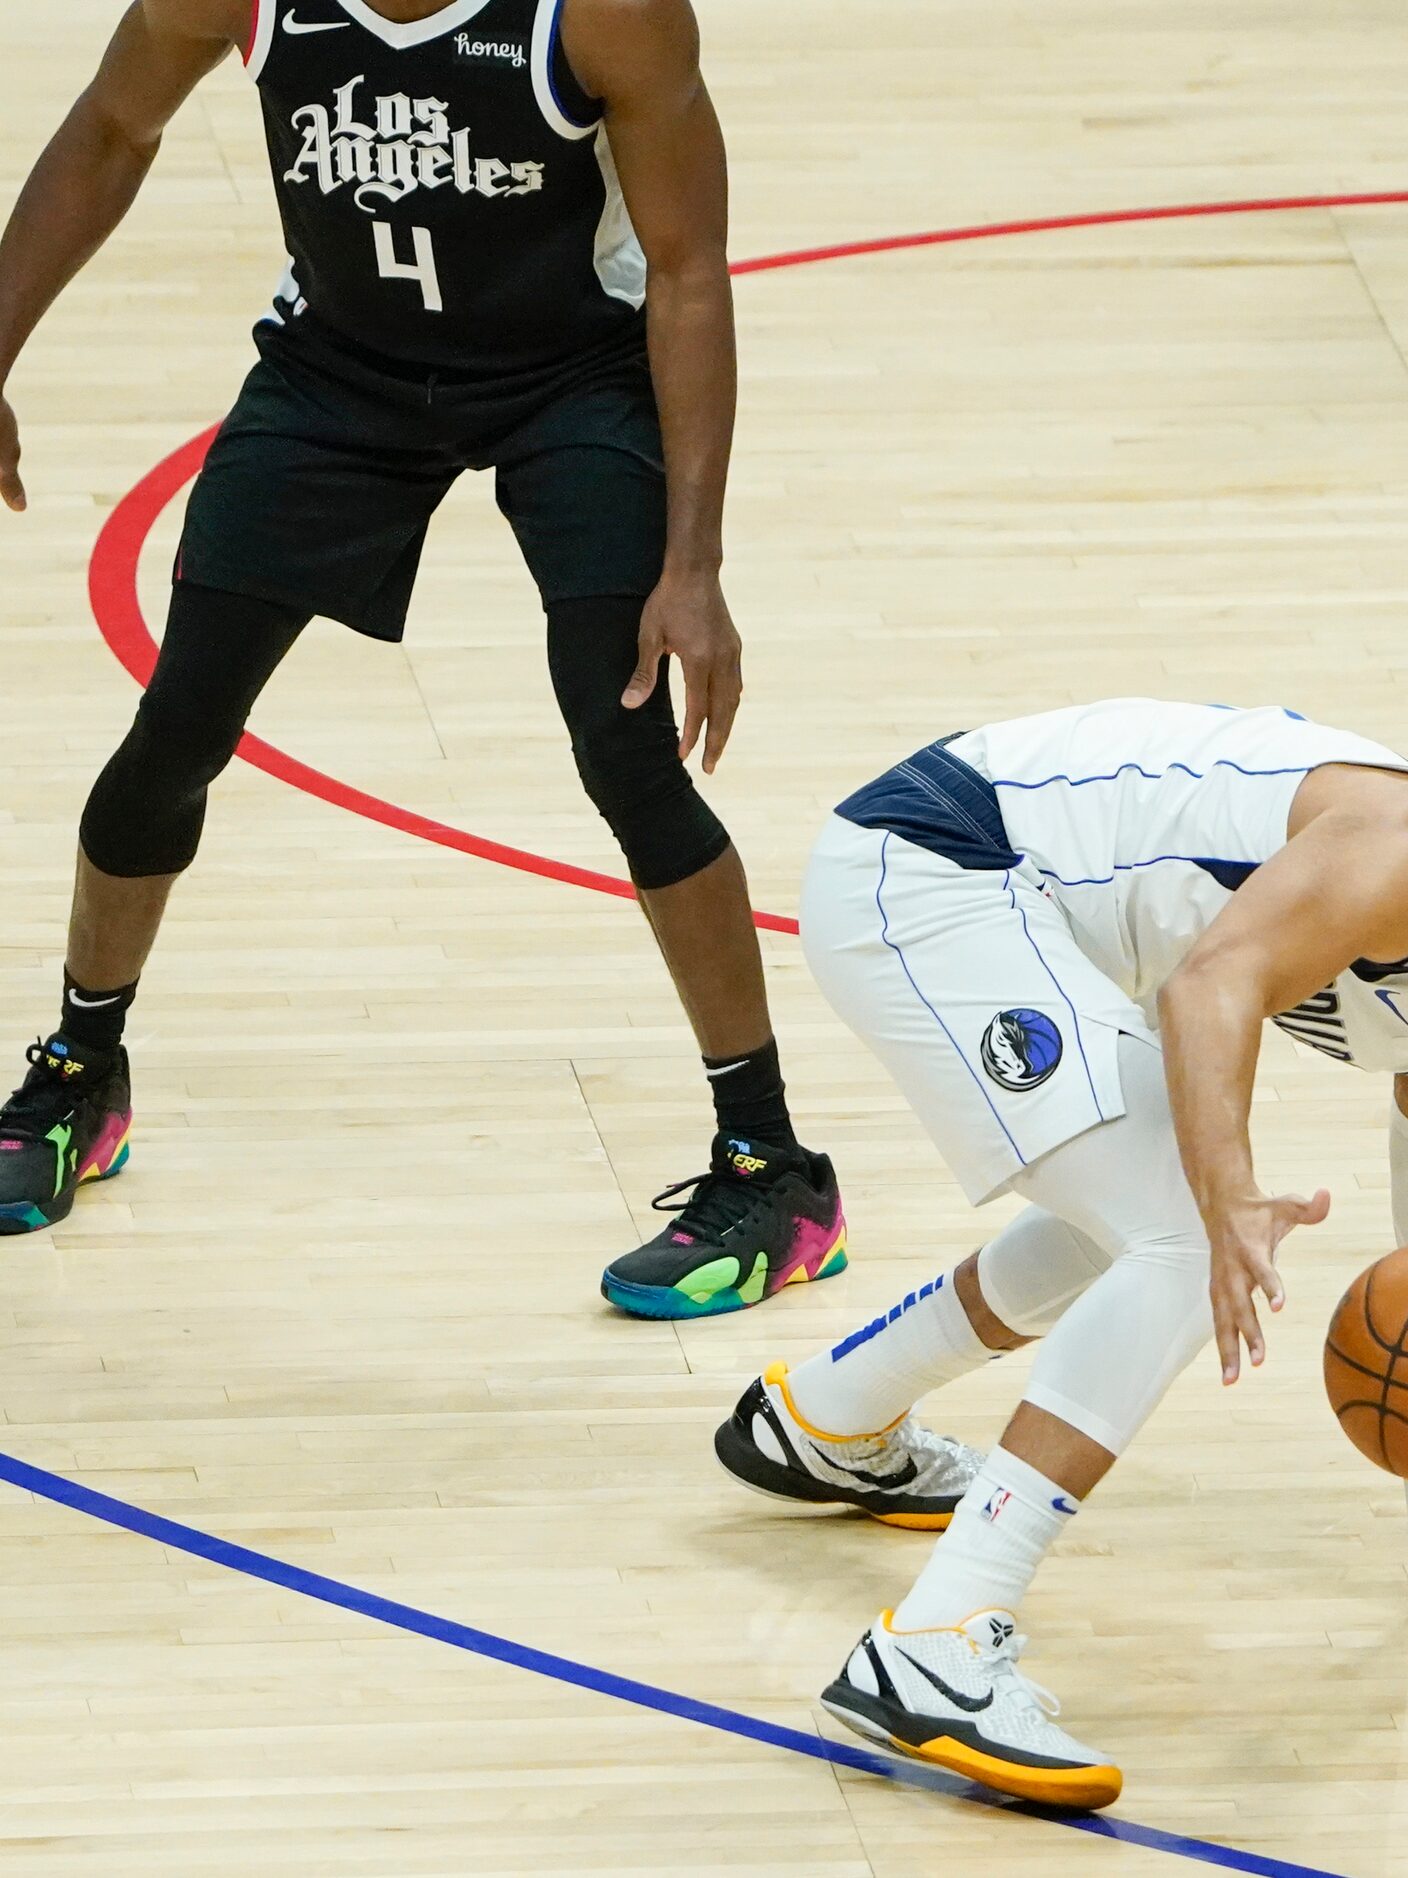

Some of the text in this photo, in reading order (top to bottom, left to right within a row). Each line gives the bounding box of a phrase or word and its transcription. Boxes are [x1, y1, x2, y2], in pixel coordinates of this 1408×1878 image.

[454, 32, 527, 68] honey
[330, 74, 450, 146] Los
[283, 103, 545, 213] Angeles
[372, 220, 443, 312] 4
